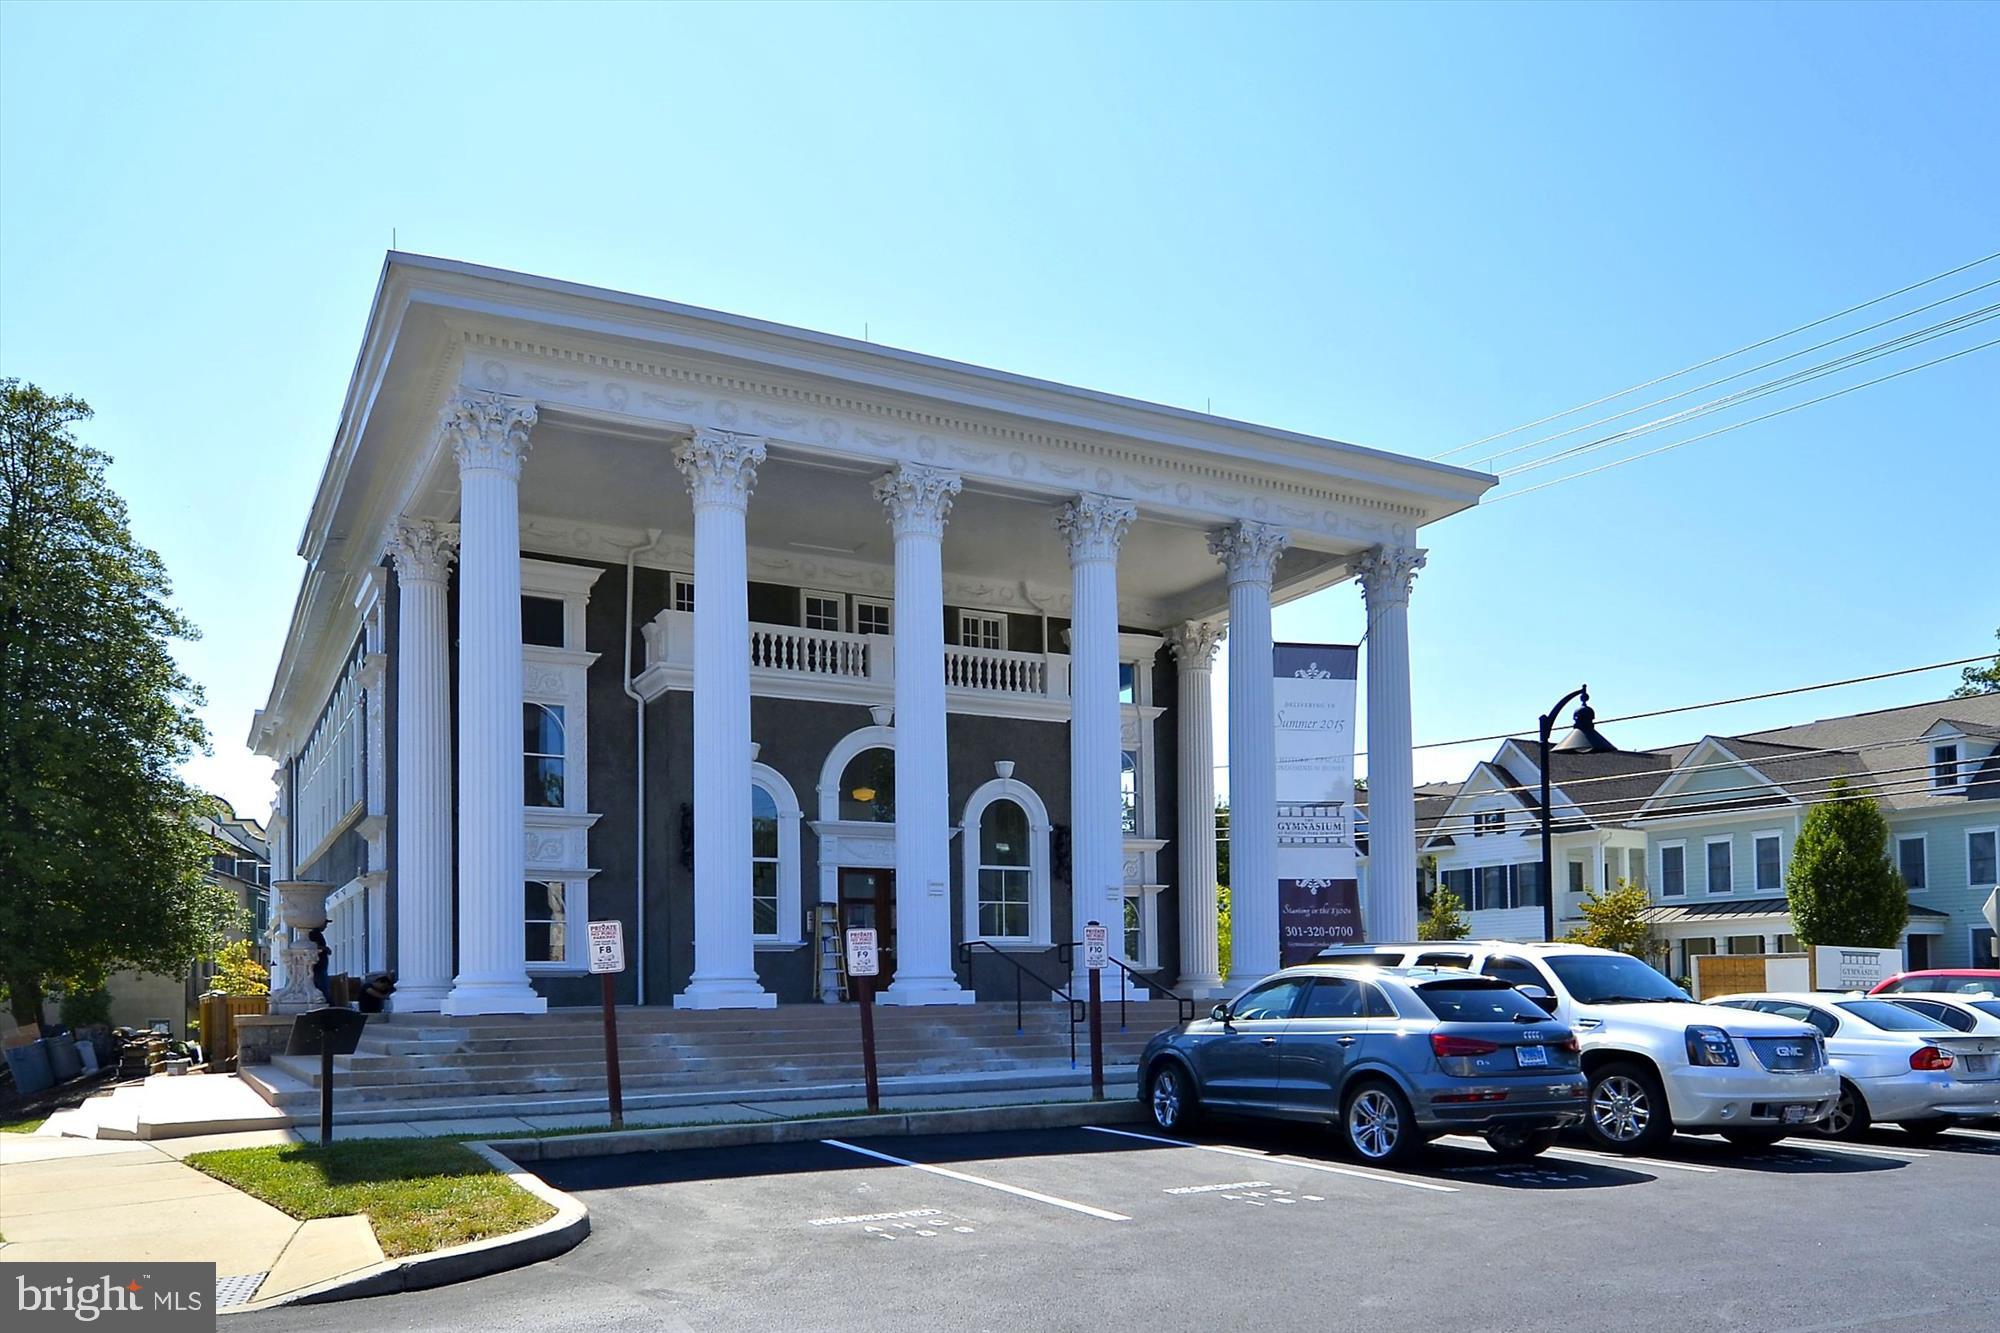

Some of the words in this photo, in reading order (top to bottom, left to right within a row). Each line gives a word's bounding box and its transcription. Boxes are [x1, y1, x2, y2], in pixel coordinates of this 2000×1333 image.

[1275, 710, 1318, 729] Summer
[1320, 719, 1345, 733] 2015
[1277, 822, 1342, 831] GYMNASIUM
[1320, 902, 1330, 914] the
[1285, 926, 1354, 937] 301-320-0700
[599, 945, 612, 954] F8
[857, 950, 869, 959] F9
